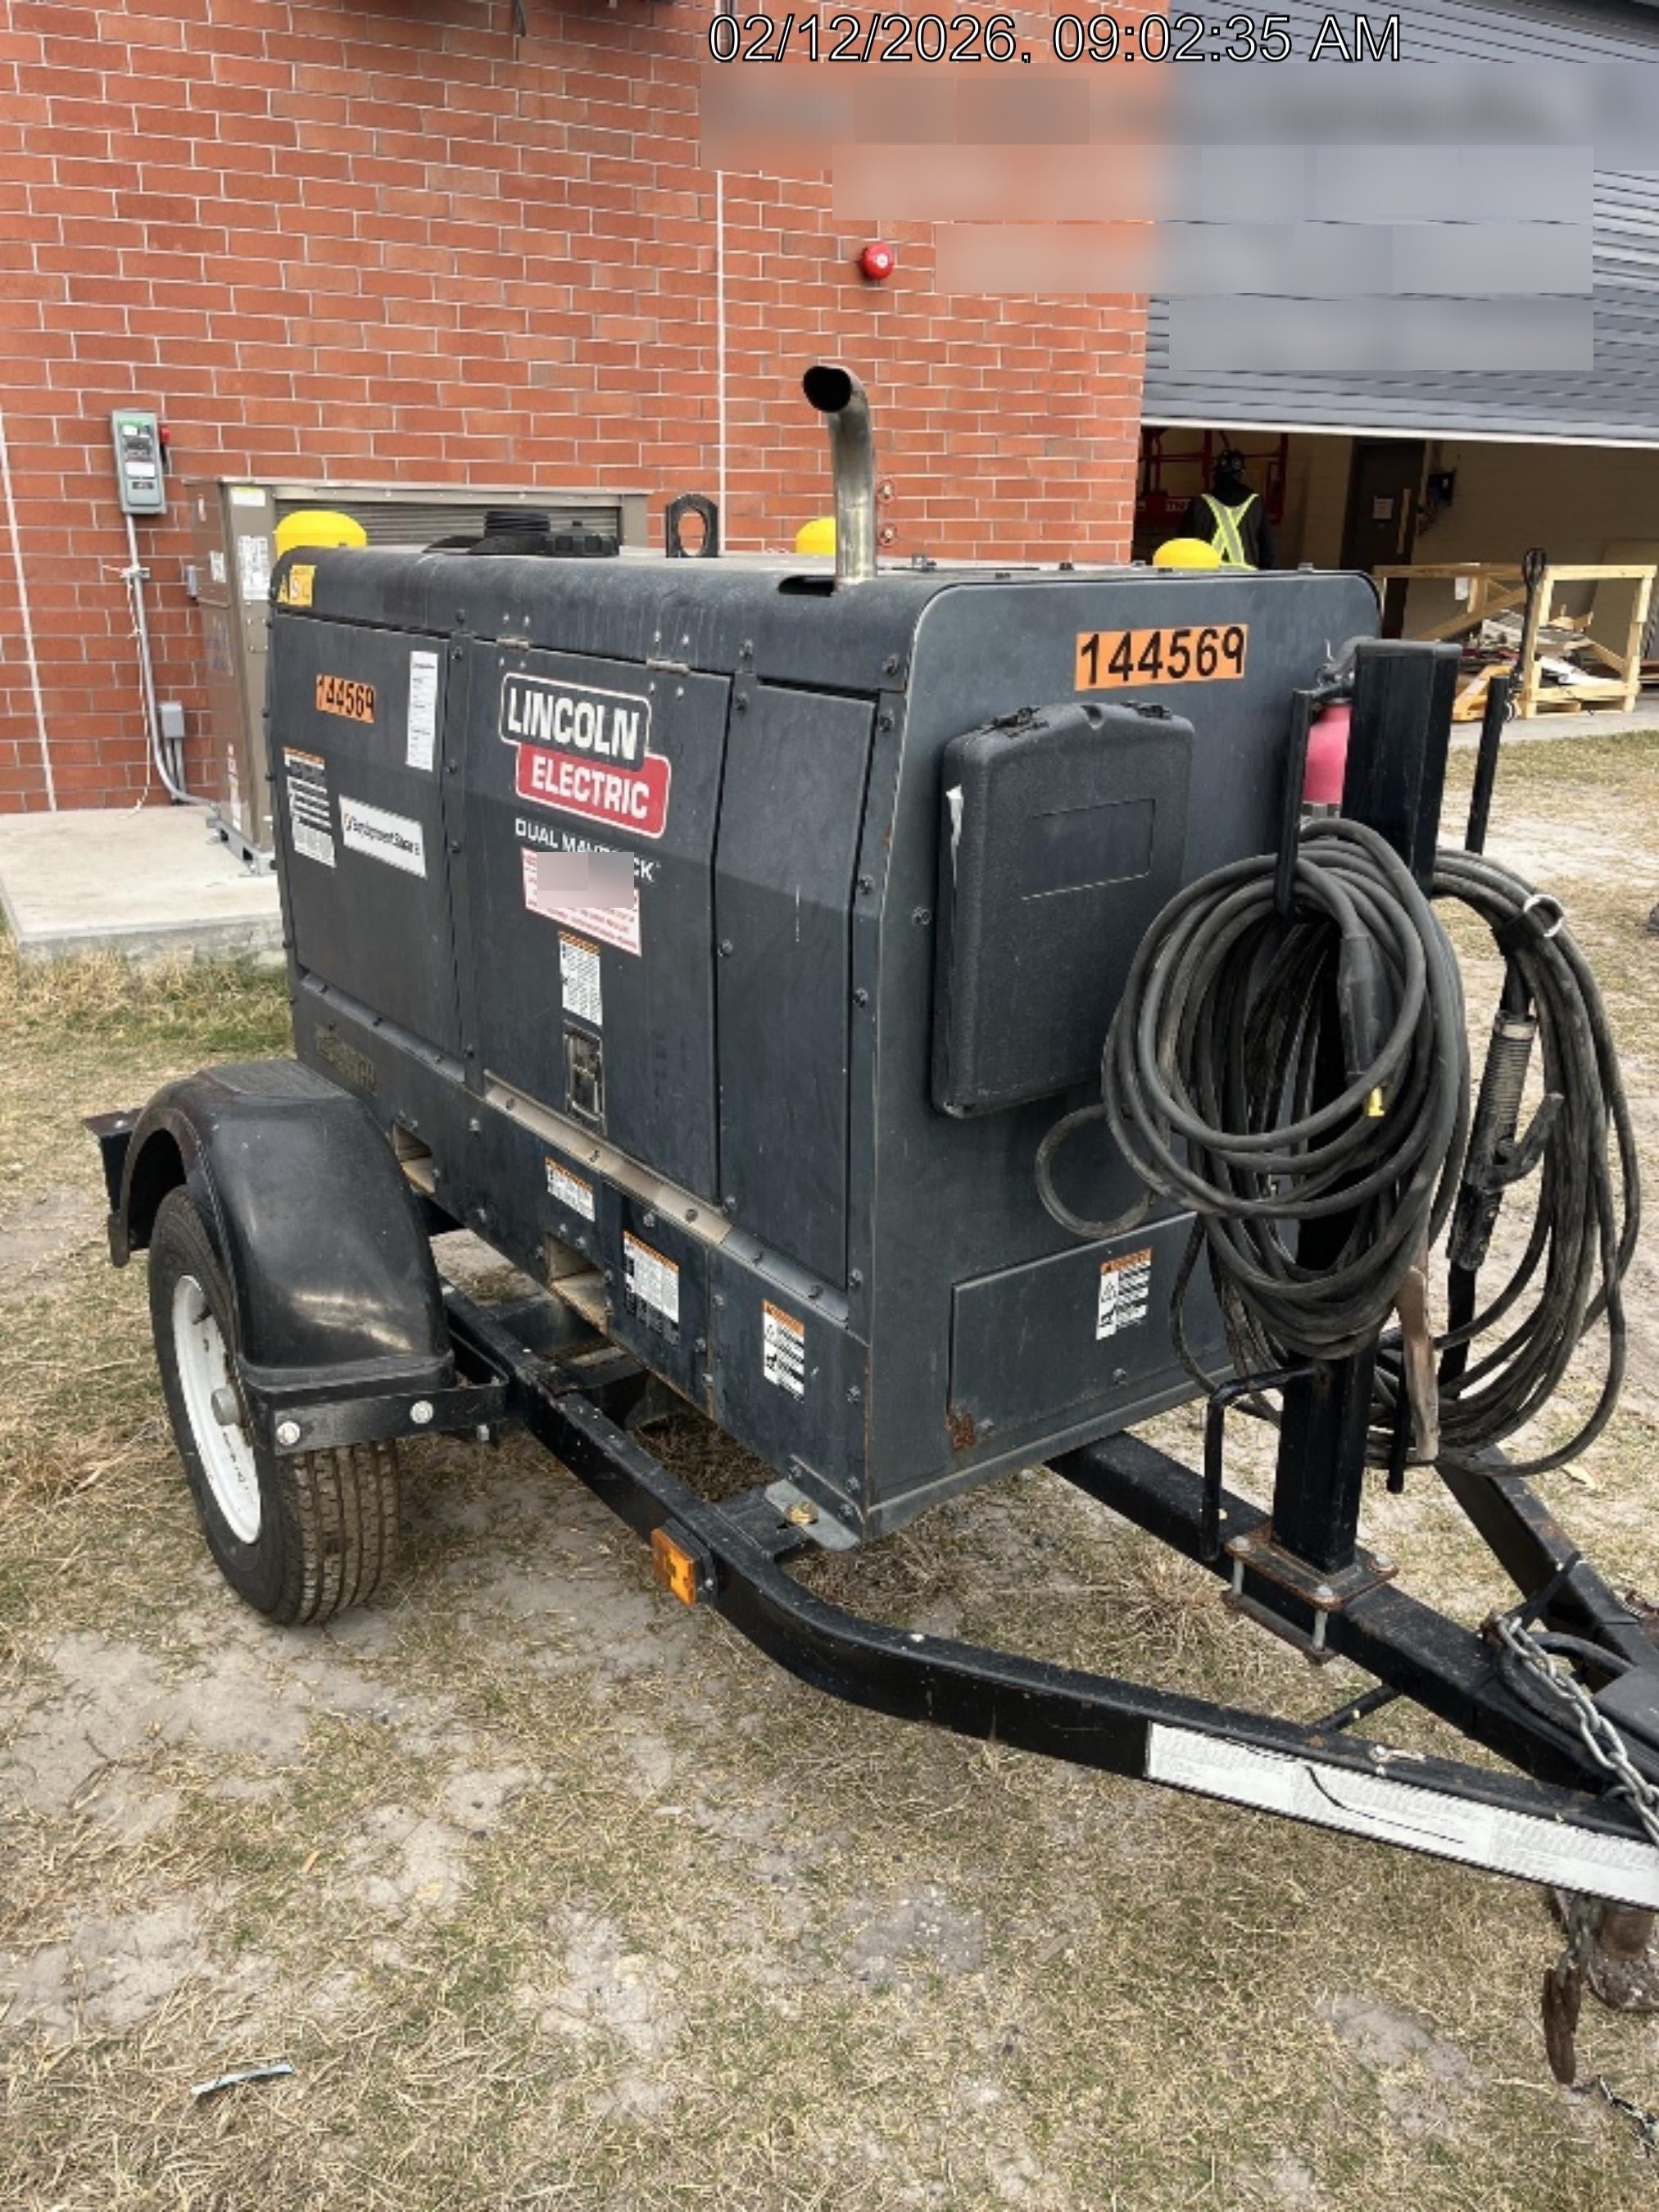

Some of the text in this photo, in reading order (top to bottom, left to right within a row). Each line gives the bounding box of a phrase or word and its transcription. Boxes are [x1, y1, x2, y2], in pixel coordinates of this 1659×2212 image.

[1081, 626, 1244, 685] 144569
[318, 676, 374, 720] 144569
[507, 687, 640, 760] LINCOLN
[531, 755, 650, 819] ELECTRIC
[515, 818, 558, 849] DUAL
